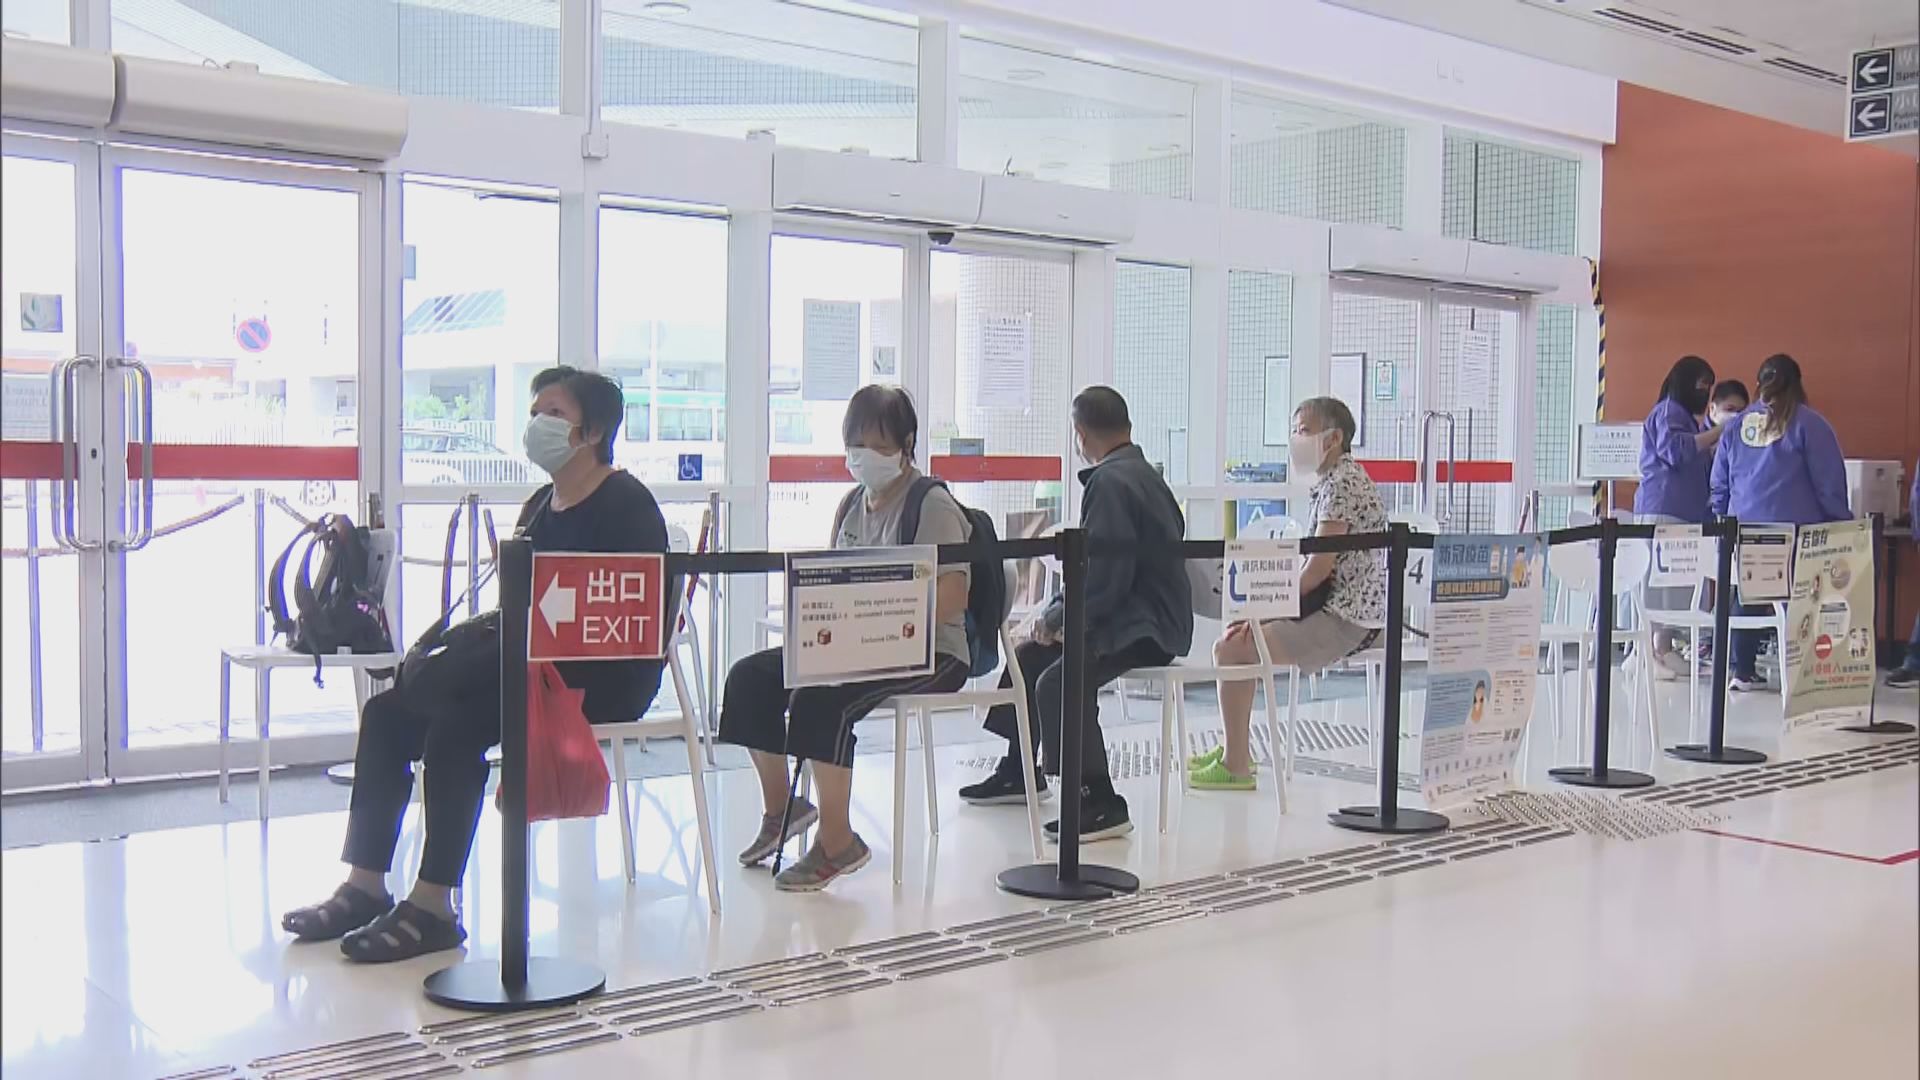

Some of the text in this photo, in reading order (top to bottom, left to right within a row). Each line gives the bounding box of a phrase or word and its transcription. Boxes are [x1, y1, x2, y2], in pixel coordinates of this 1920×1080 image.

[1438, 544, 1489, 566] 新冠疫苗
[1408, 556, 1424, 584] 4
[586, 568, 645, 603] 出口
[1250, 591, 1289, 603] Waiting Area
[582, 616, 651, 643] EXIT
